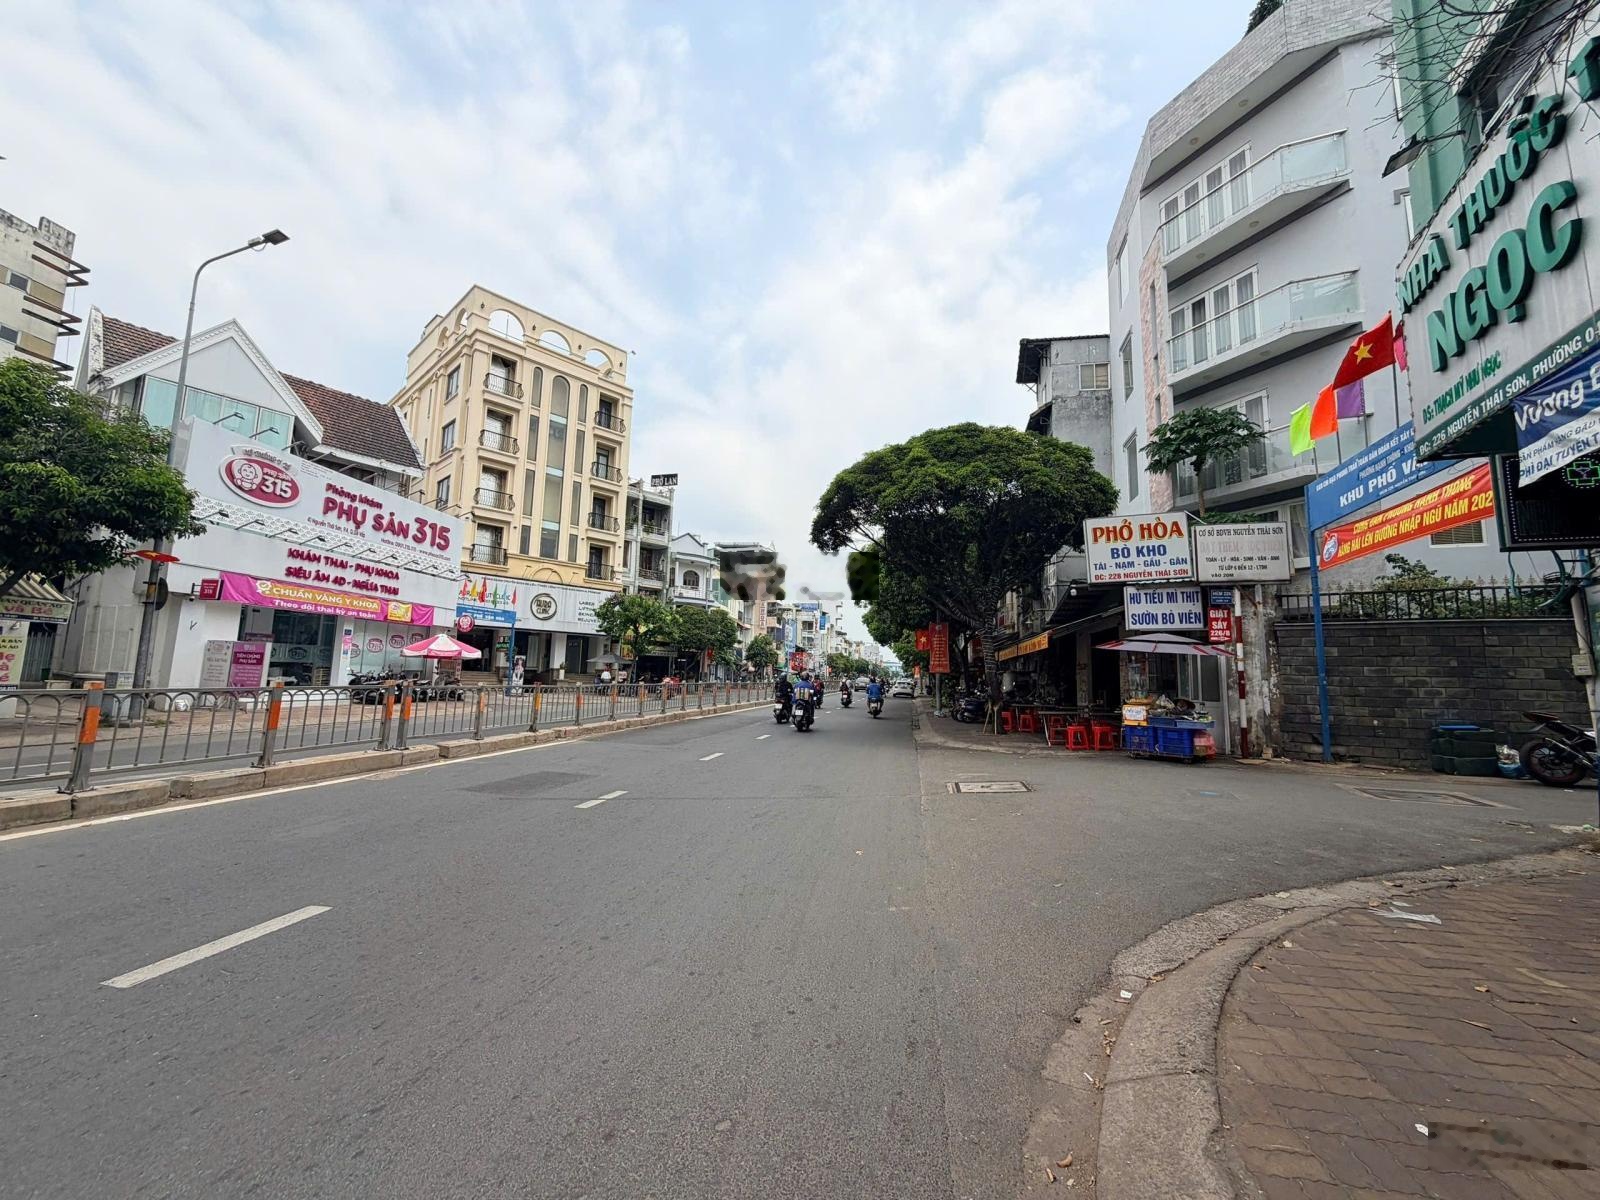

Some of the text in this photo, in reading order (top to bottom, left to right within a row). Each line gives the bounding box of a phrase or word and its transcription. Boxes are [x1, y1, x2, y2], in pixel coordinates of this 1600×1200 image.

[1448, 94, 1567, 250] THUỐC
[1426, 180, 1583, 373] NGỌC
[1432, 431, 1446, 447] 226
[1447, 406, 1480, 436] NGUYỄN
[1481, 387, 1504, 413] THÁI
[1532, 337, 1582, 378] PHƯỜNG
[1514, 379, 1584, 431] Vương
[261, 475, 291, 498] 315
[325, 483, 383, 509] Phòng khám
[1339, 484, 1364, 507] KHU
[1368, 462, 1397, 493] PHỐ
[322, 497, 367, 529] PHỤ
[372, 512, 409, 539] SẢN
[412, 517, 450, 551] 315
[1138, 516, 1184, 540] HÒA
[1400, 515, 1421, 534] NHẬP
[1444, 497, 1468, 518] NĂM
[288, 548, 399, 580] KHÁM THAI PHỤ KHOA
[1110, 544, 1167, 559] BÒ KHO
[1115, 561, 1135, 571] NẠM
[331, 577, 346, 586] 4D
[379, 584, 399, 596] THAI
[1144, 589, 1163, 605] TIẾU
[1166, 588, 1178, 603] MÌ
[1180, 590, 1200, 606] THỊT
[273, 599, 298, 609] Theo
[317, 605, 334, 613] thai
[315, 593, 342, 604] VÀNG
[353, 599, 378, 609] KHOA
[1131, 610, 1158, 626] SƯỜN
[1178, 609, 1201, 625] VIÊN
